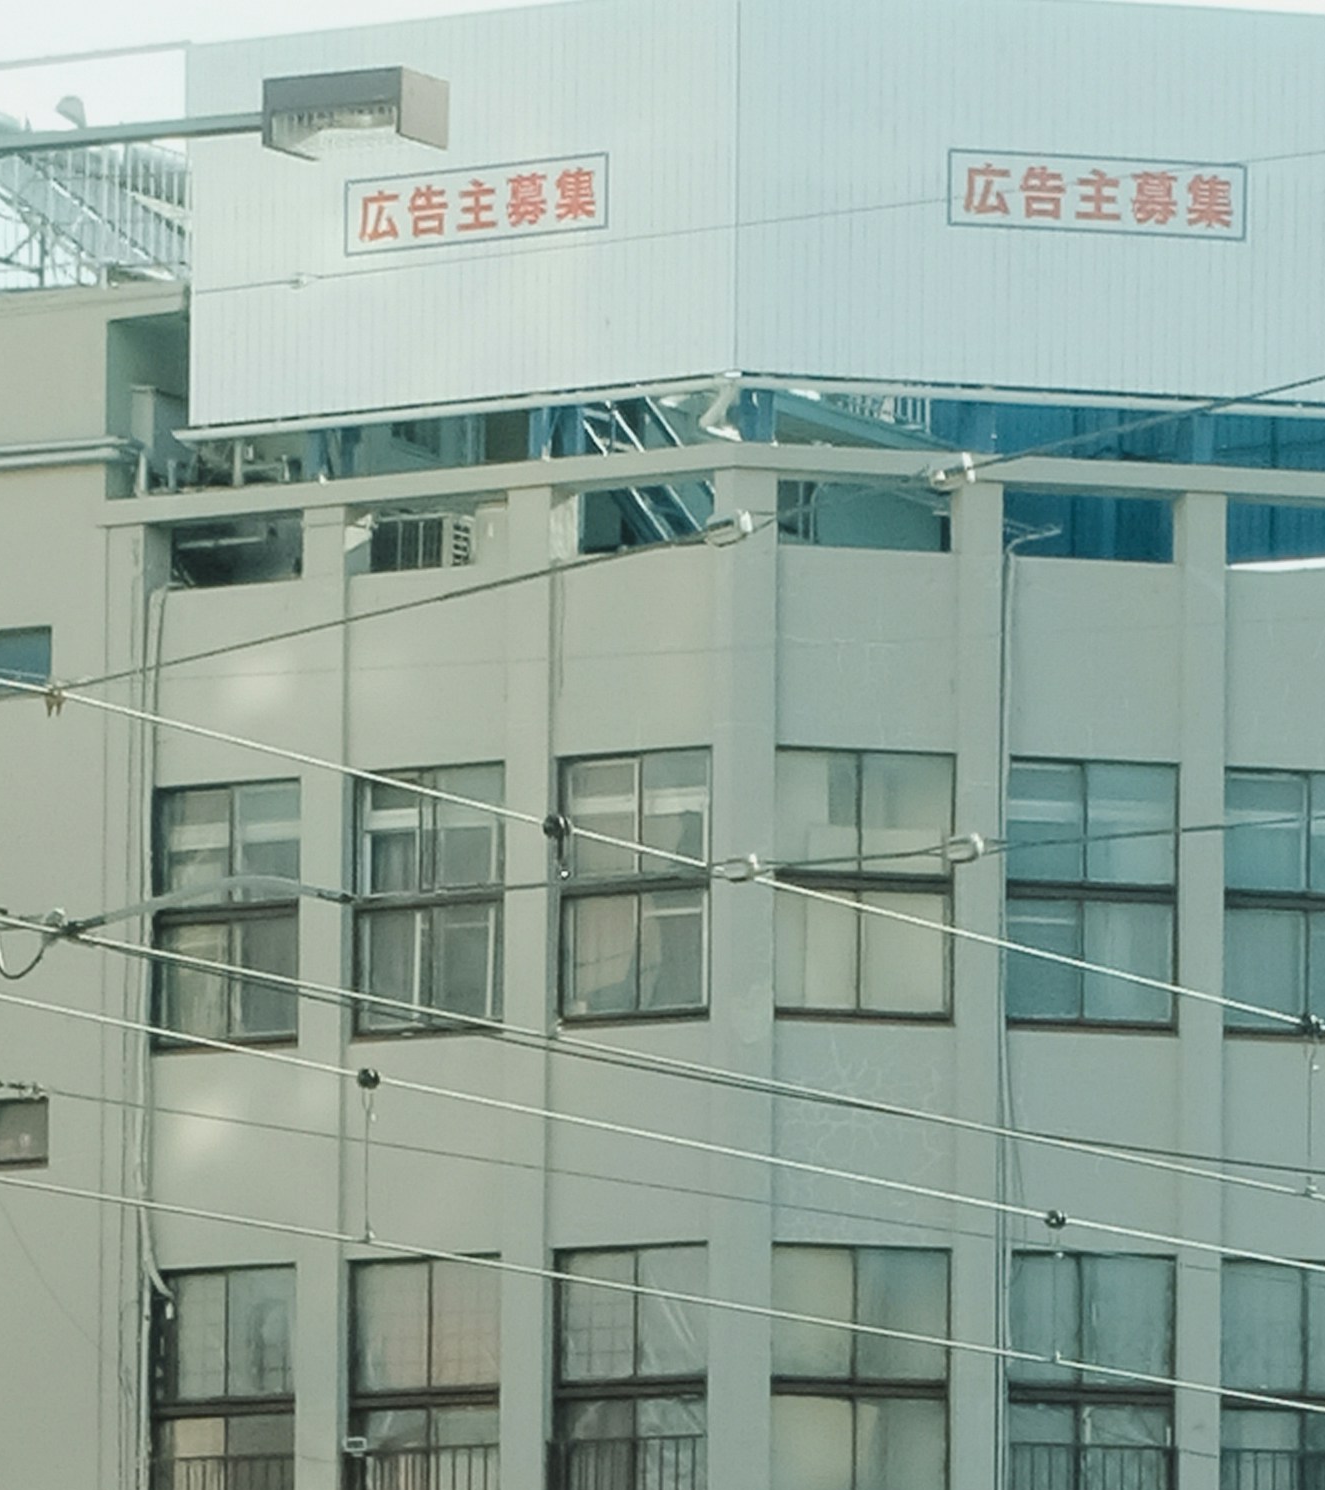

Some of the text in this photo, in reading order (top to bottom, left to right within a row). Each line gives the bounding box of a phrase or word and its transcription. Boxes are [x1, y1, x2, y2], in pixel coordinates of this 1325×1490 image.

[359, 167, 598, 241] 広告主募集
[963, 163, 1235, 229] 広告主募集
